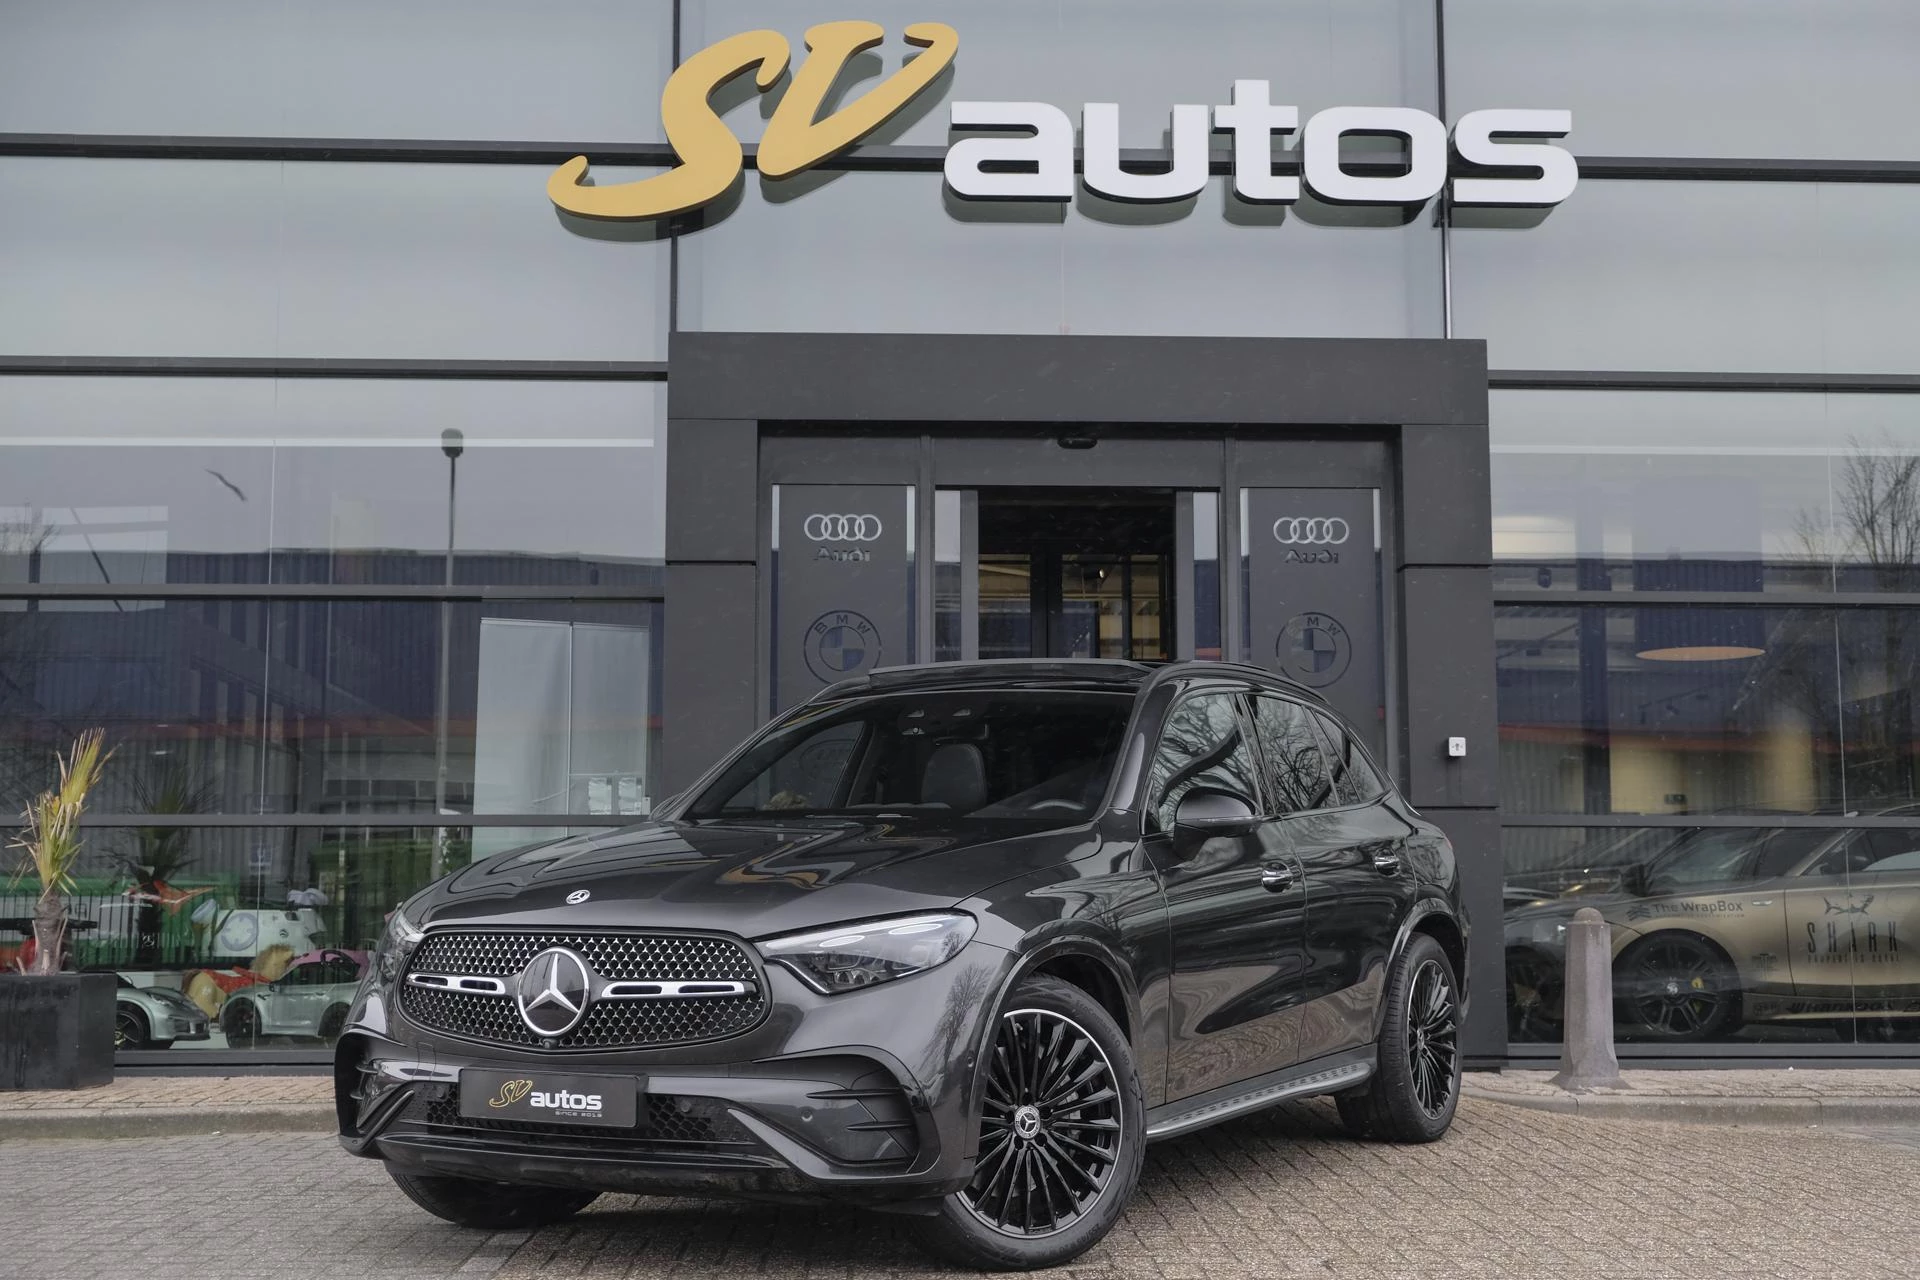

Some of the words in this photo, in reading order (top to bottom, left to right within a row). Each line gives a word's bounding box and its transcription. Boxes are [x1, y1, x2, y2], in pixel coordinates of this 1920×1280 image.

[546, 21, 960, 218] SV
[944, 79, 1579, 205] autos
[814, 546, 871, 562] Audi
[1284, 549, 1340, 564] Audi
[814, 614, 871, 635] BMW
[1652, 903, 1678, 913] The
[1681, 900, 1744, 913] WrapBox
[1807, 921, 1898, 953] SHARK
[489, 1079, 534, 1107] SV
[530, 1089, 603, 1110] autos
